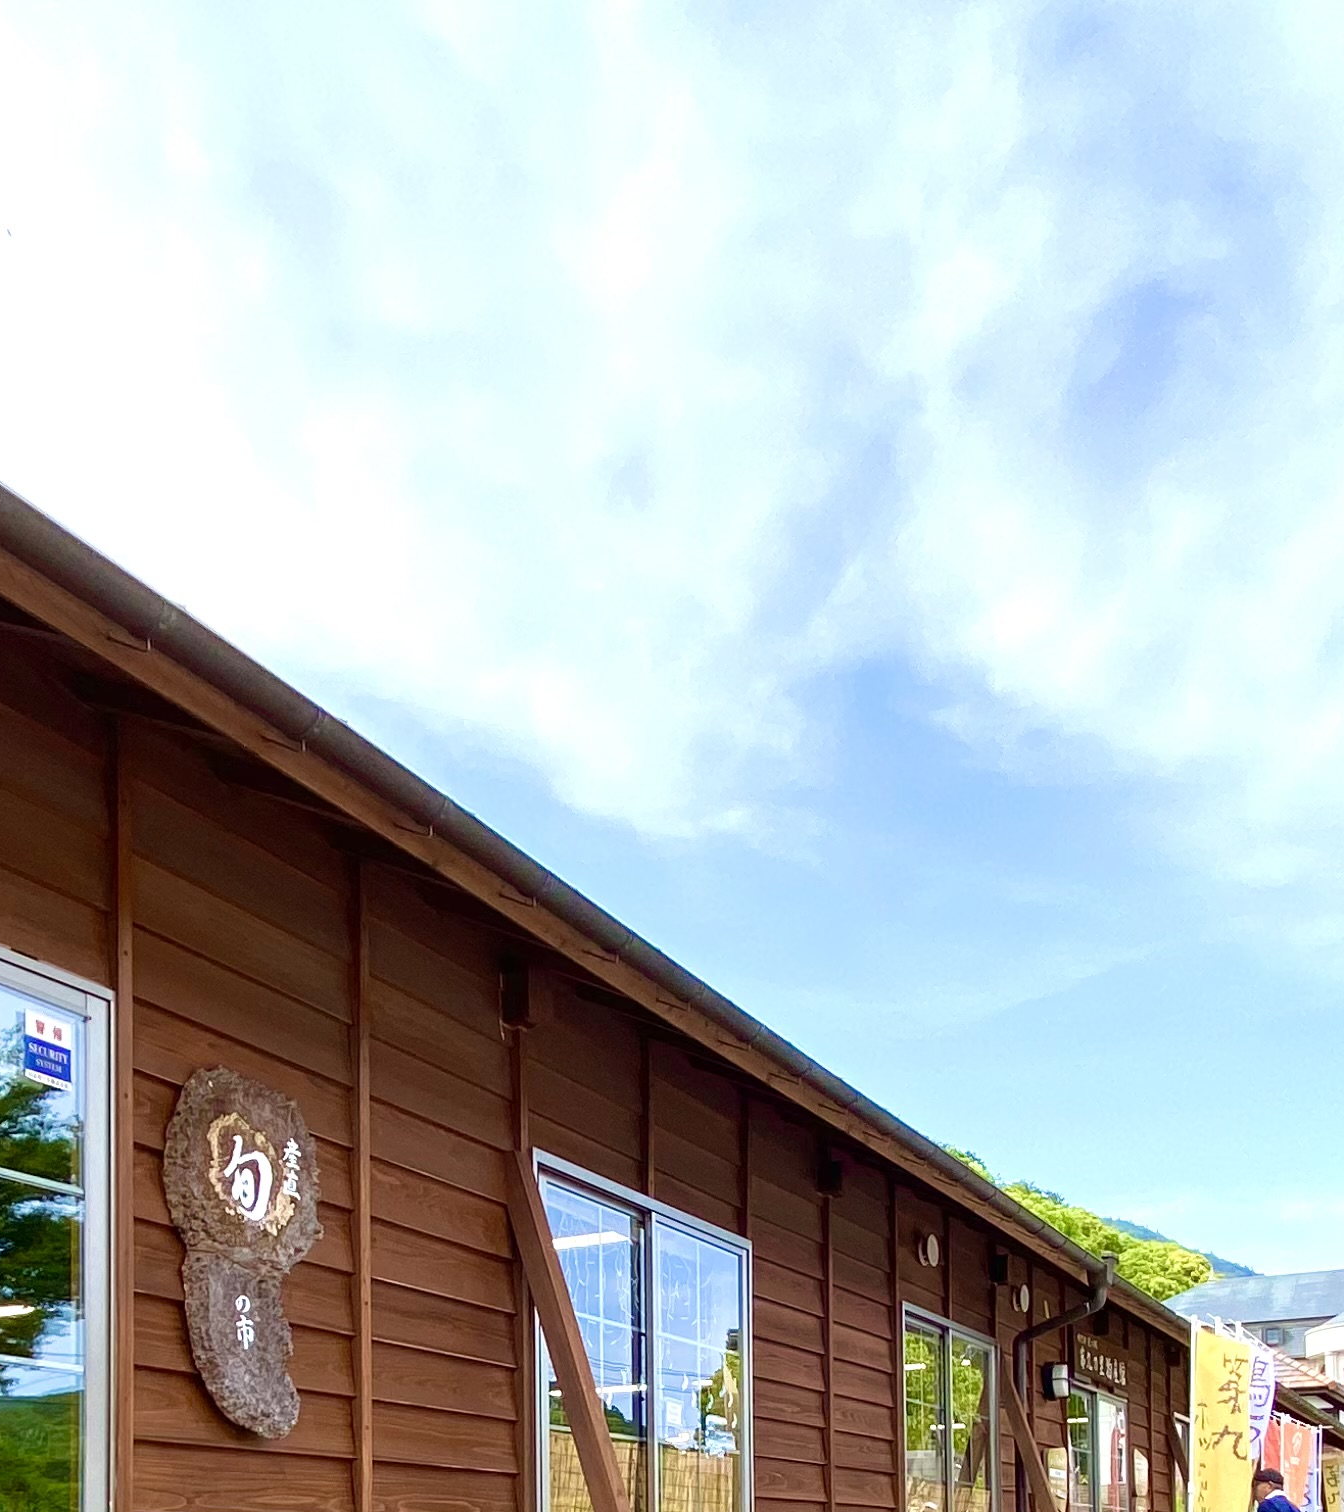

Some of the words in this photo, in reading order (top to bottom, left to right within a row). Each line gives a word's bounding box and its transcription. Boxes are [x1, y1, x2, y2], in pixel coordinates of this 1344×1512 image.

[28, 1042, 68, 1065] SECURITY
[35, 1058, 63, 1074] SYSTEM
[224, 1134, 273, 1222] 旬
[282, 1138, 302, 1201] 産直
[235, 1294, 255, 1350] の市
